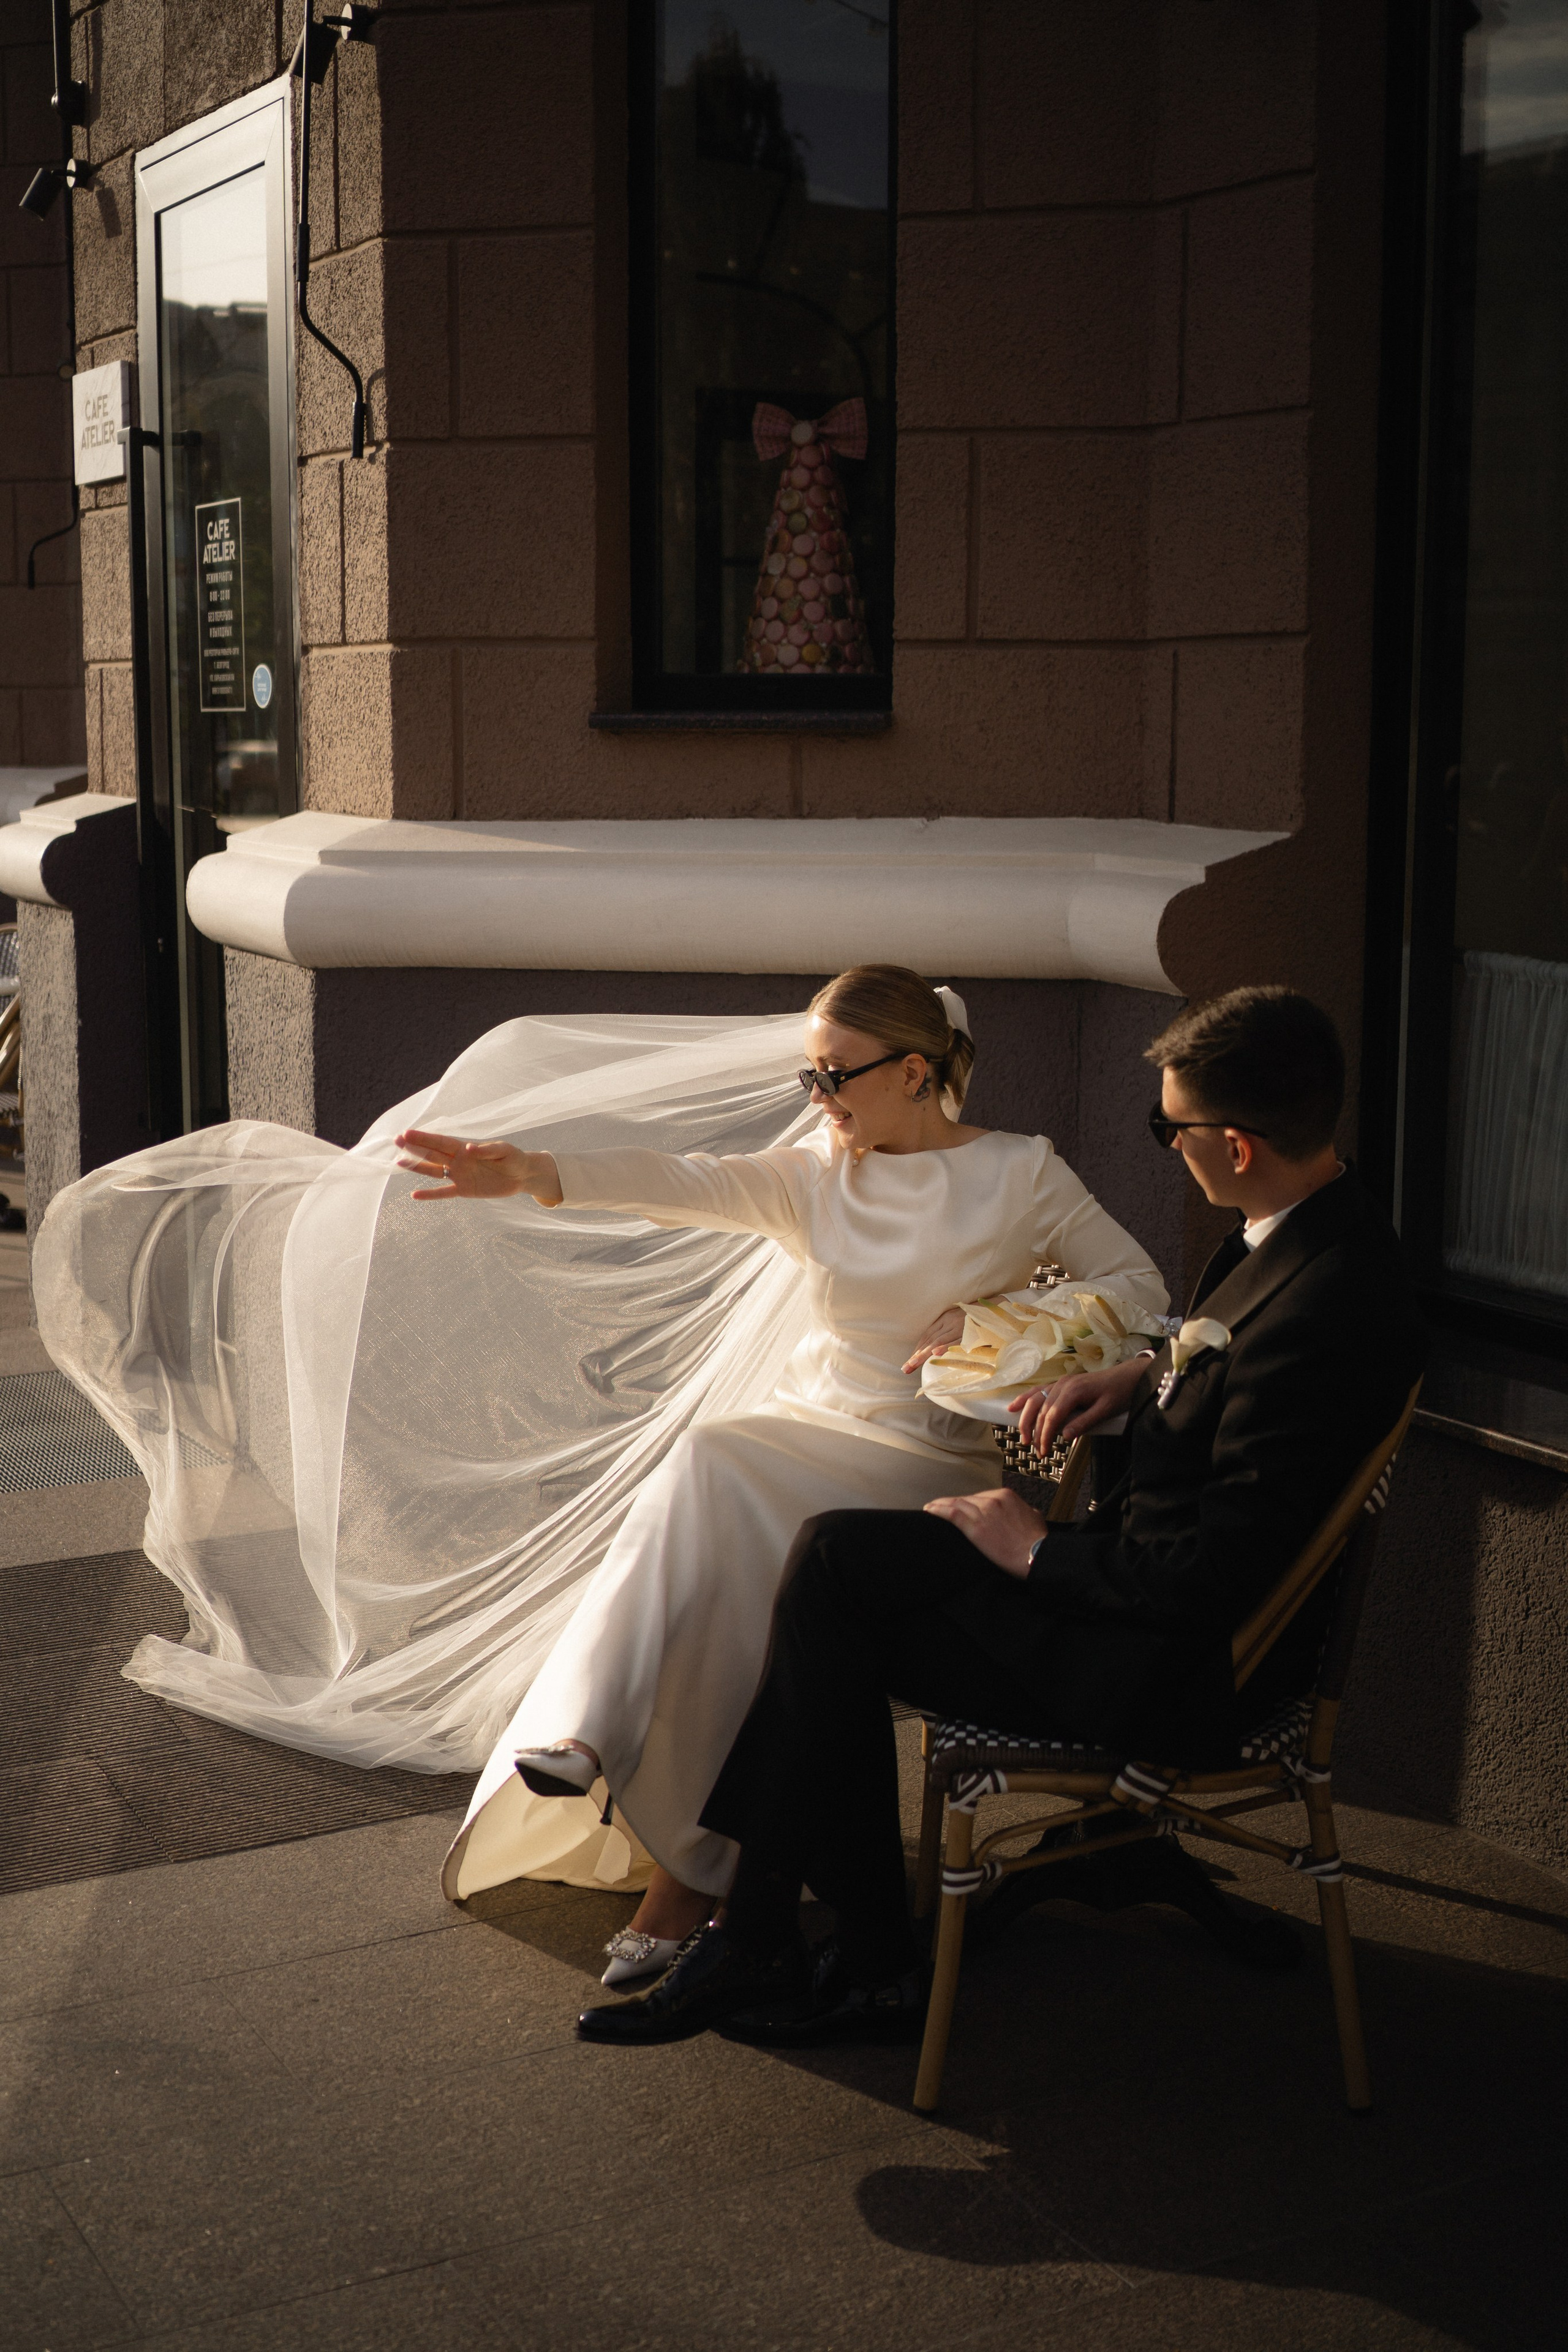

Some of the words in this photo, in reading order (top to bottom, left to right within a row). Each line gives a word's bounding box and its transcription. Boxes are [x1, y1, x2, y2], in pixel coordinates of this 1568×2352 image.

[85, 394, 108, 422] CAFE
[81, 420, 115, 451] ATELIER
[207, 518, 230, 541] CAFE
[203, 540, 235, 564] ATELIER
[219, 571, 233, 582] РАБОТЫ
